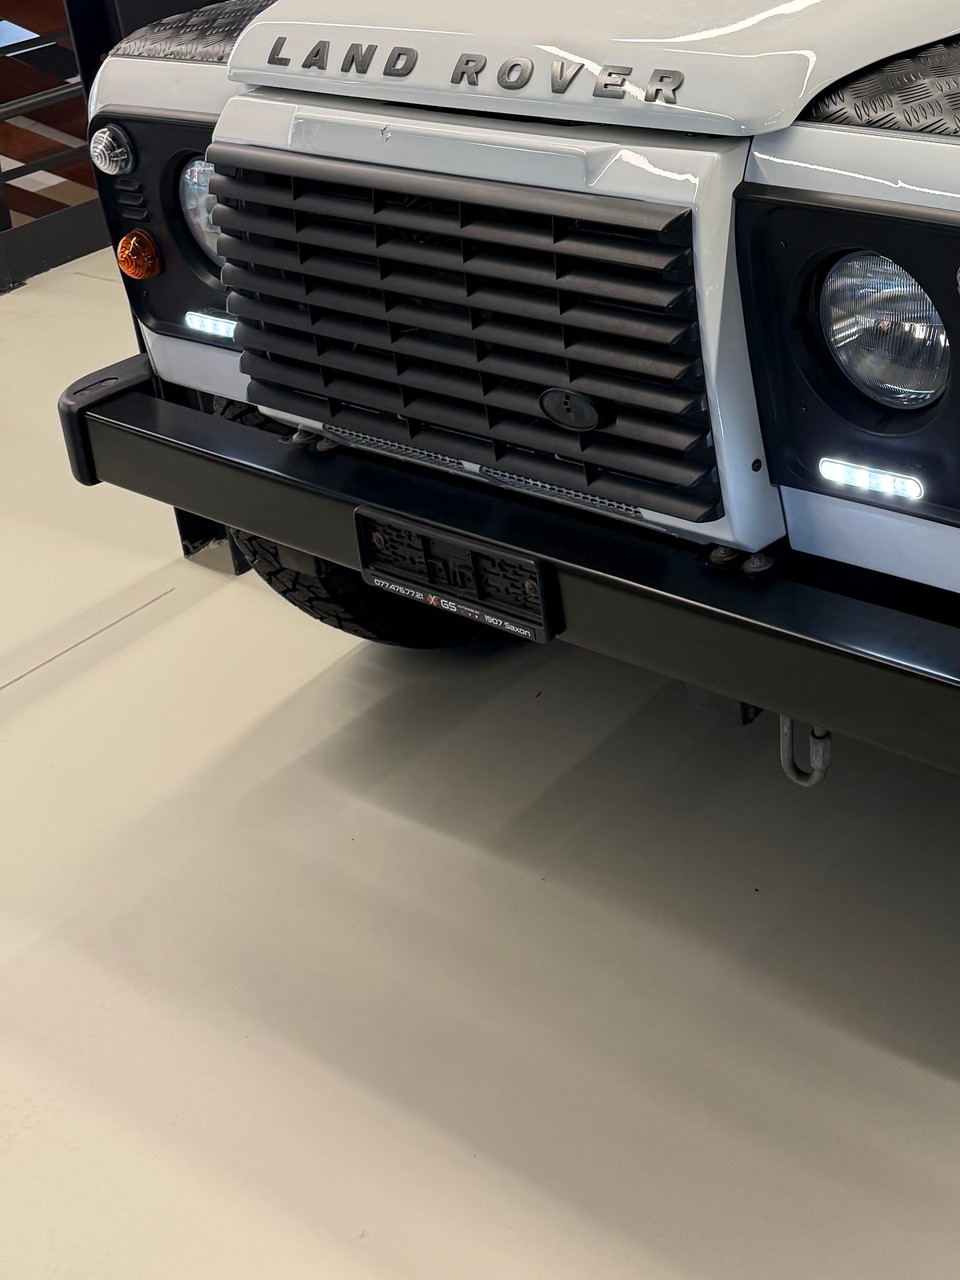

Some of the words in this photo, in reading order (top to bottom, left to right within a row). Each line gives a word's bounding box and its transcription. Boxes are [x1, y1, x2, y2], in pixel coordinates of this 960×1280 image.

[267, 36, 418, 78] LAND
[450, 53, 685, 105] ROVER
[440, 599, 457, 612] GS
[484, 614, 503, 626] 1907
[504, 621, 531, 637] Saxon
